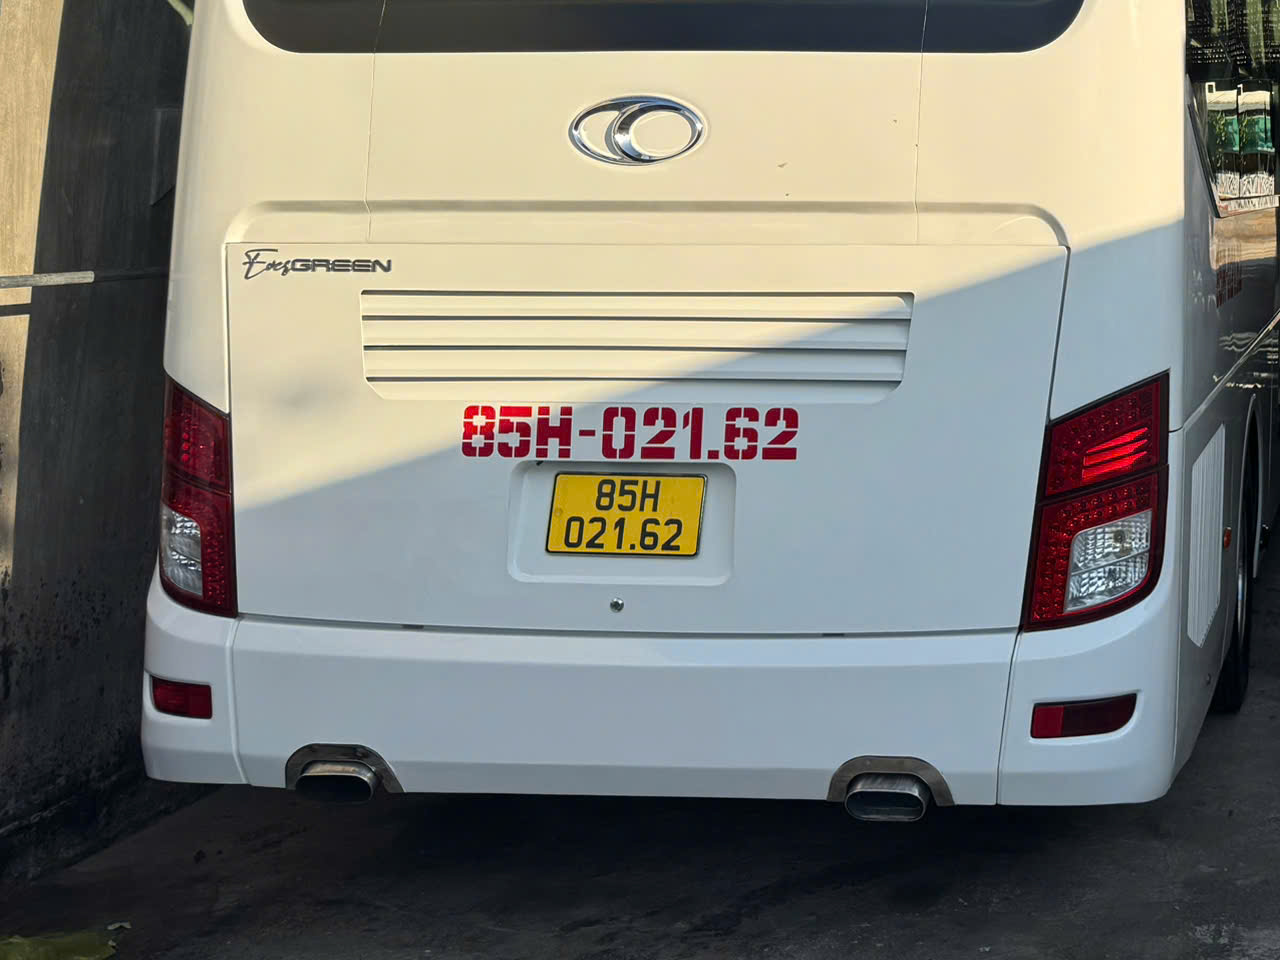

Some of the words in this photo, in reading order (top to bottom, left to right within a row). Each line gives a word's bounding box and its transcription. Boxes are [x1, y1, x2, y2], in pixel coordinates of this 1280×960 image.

[461, 405, 800, 461] 85H-021.62
[595, 479, 661, 512] 85H
[563, 516, 683, 551] 021.62
